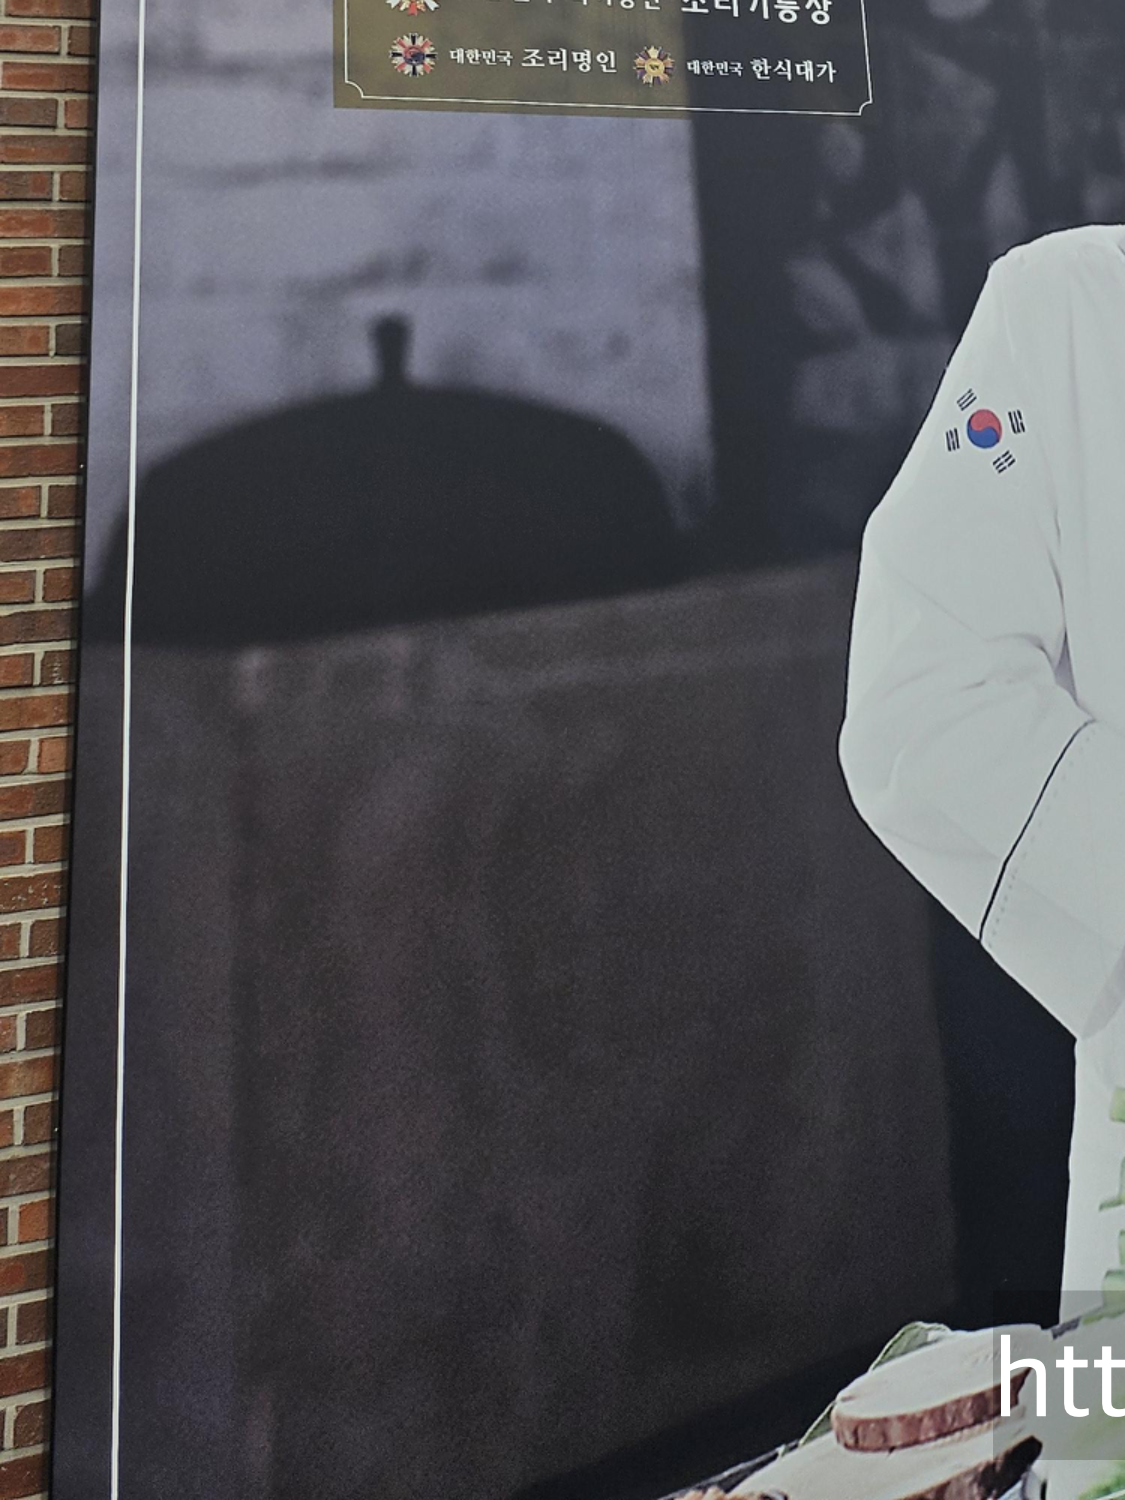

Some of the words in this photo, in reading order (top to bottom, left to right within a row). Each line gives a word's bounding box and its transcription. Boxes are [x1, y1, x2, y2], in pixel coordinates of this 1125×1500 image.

[450, 48, 513, 66] 대한민국
[521, 48, 617, 72] 조리명인
[687, 59, 744, 77] 대한민국
[750, 57, 837, 83] 한식대가
